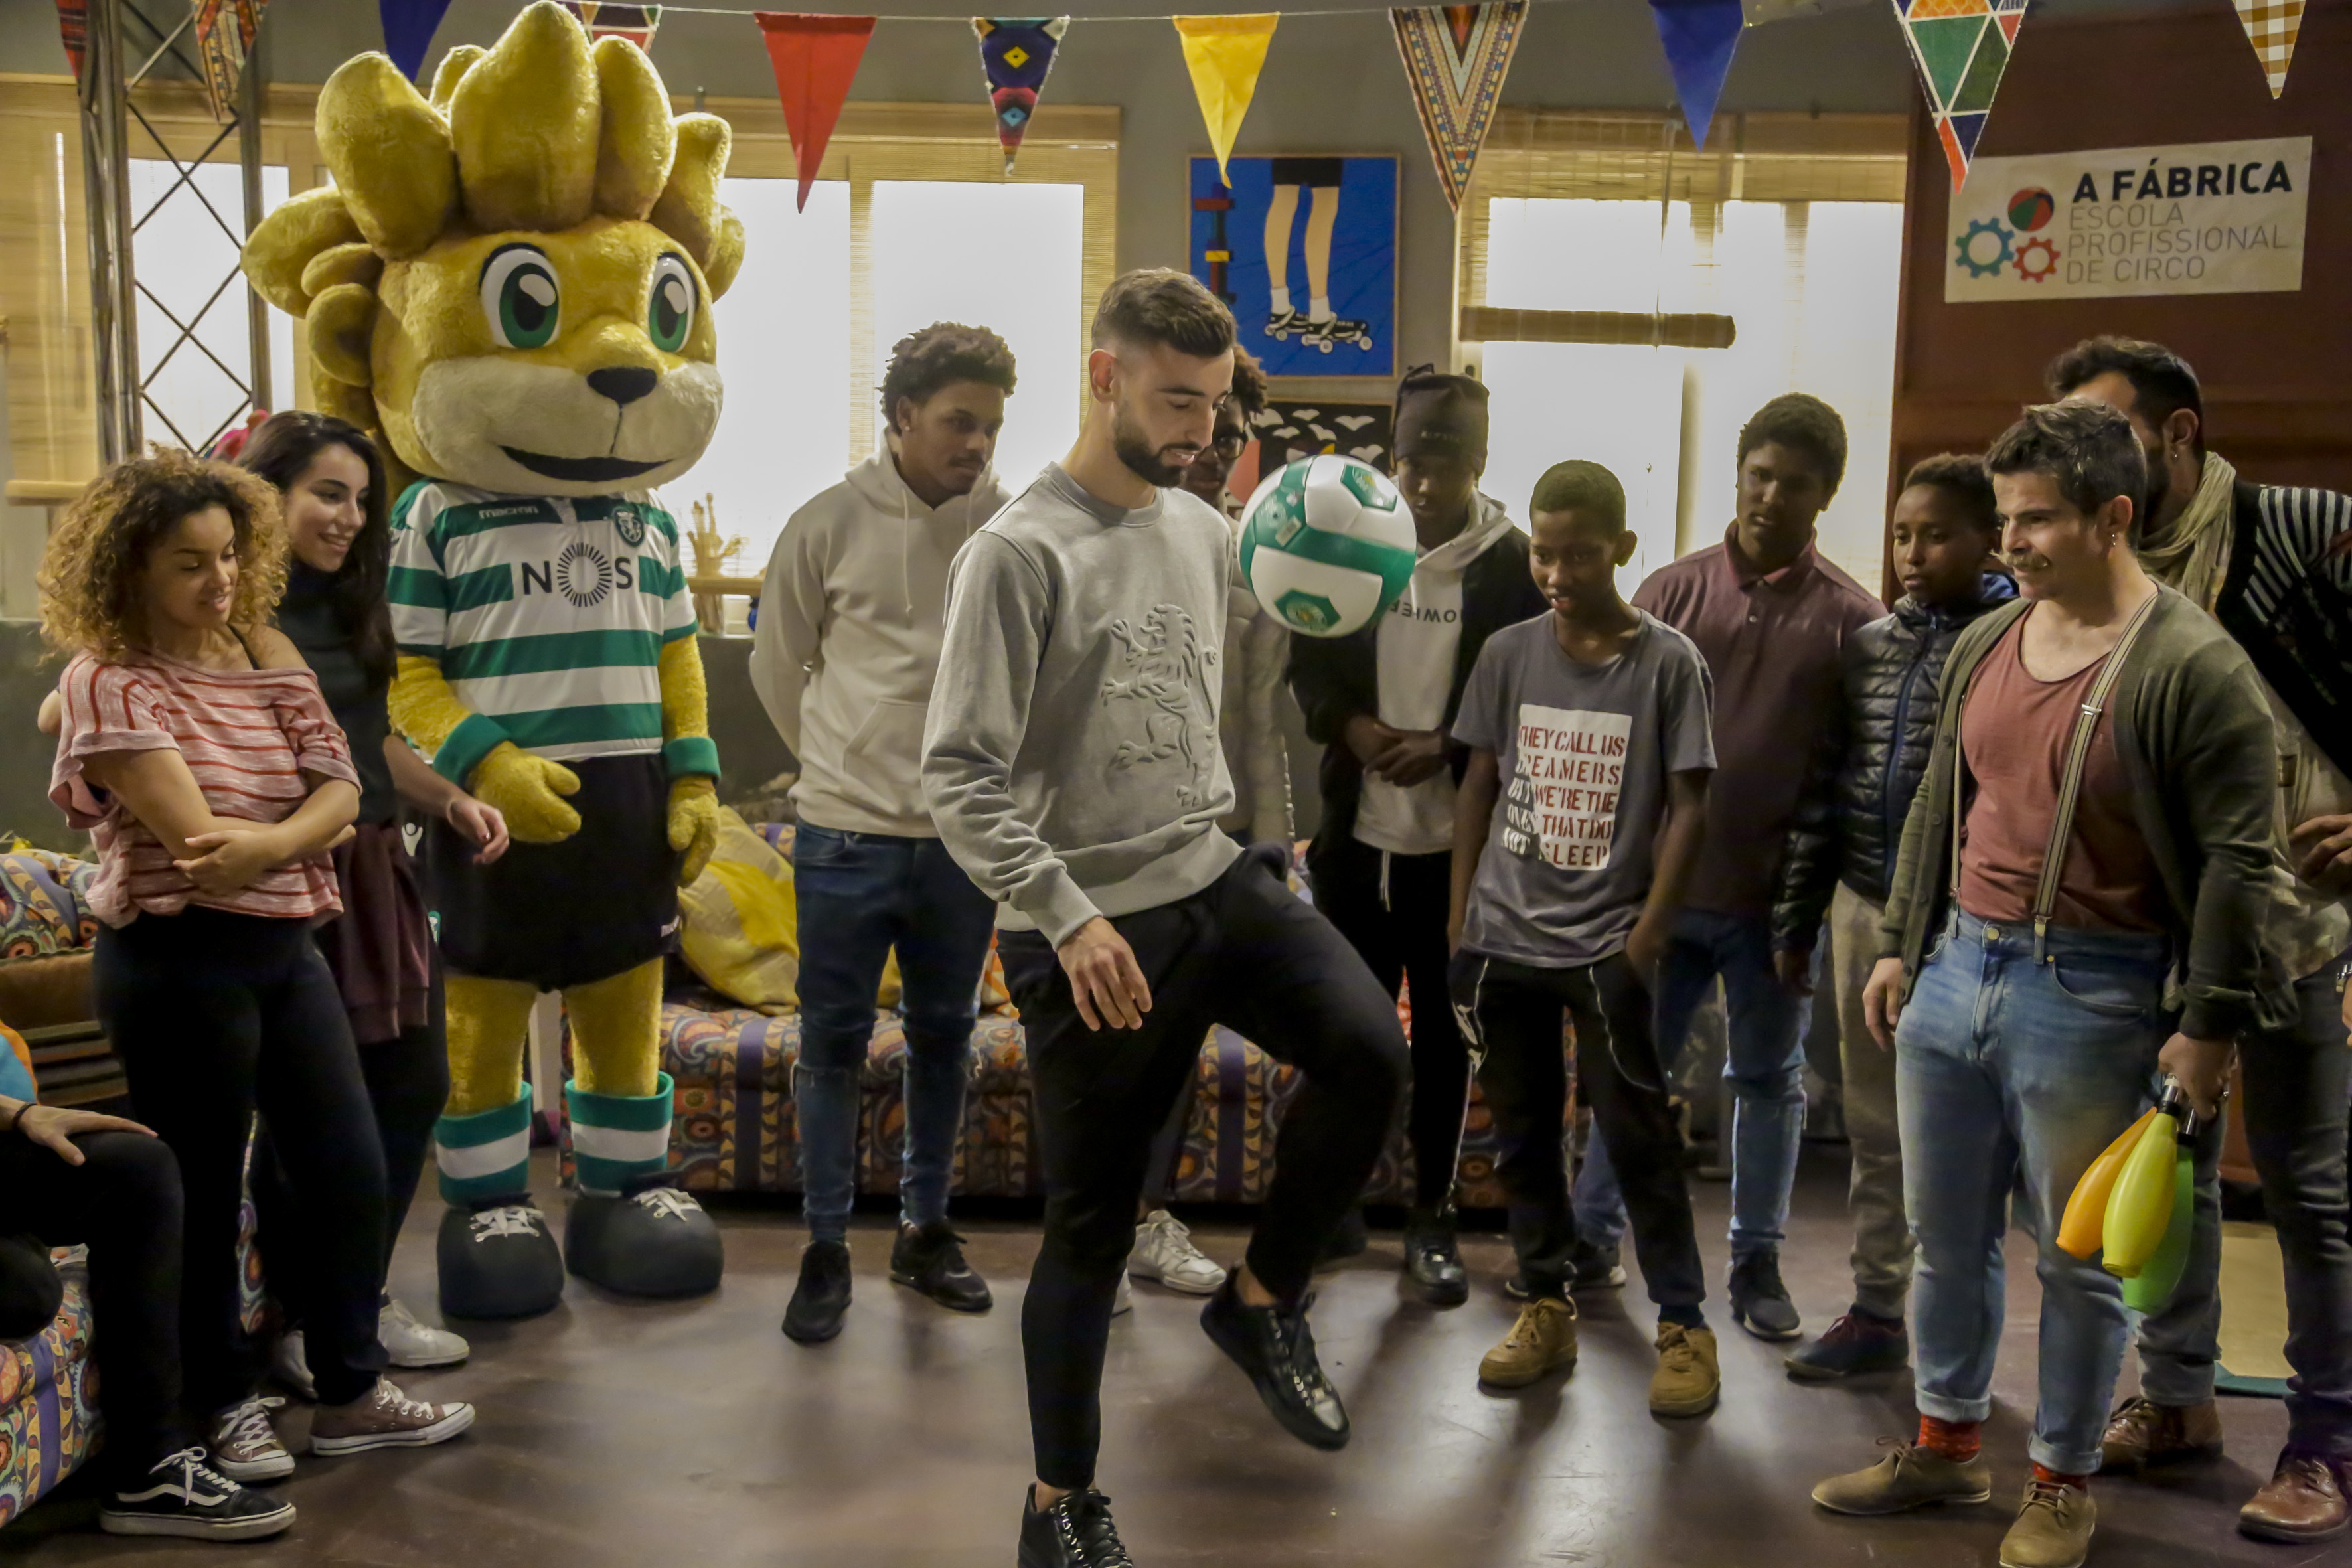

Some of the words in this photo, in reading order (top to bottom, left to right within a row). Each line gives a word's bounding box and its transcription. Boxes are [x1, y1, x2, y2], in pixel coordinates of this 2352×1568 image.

[2073, 172, 2099, 204] A
[2112, 157, 2292, 201] FÁBRICA
[2069, 202, 2185, 232] ESCOLA
[2066, 224, 2290, 258] PROFISSIONAL
[2065, 260, 2104, 285] DE
[2114, 255, 2207, 283] CIRCO
[479, 505, 539, 520] macron
[521, 542, 633, 608] NOS
[1555, 730, 1597, 755] CALL
[1601, 734, 1626, 757] US
[1587, 790, 1618, 813] THE
[1542, 814, 1585, 840] THAT
[1589, 819, 1612, 840] DO
